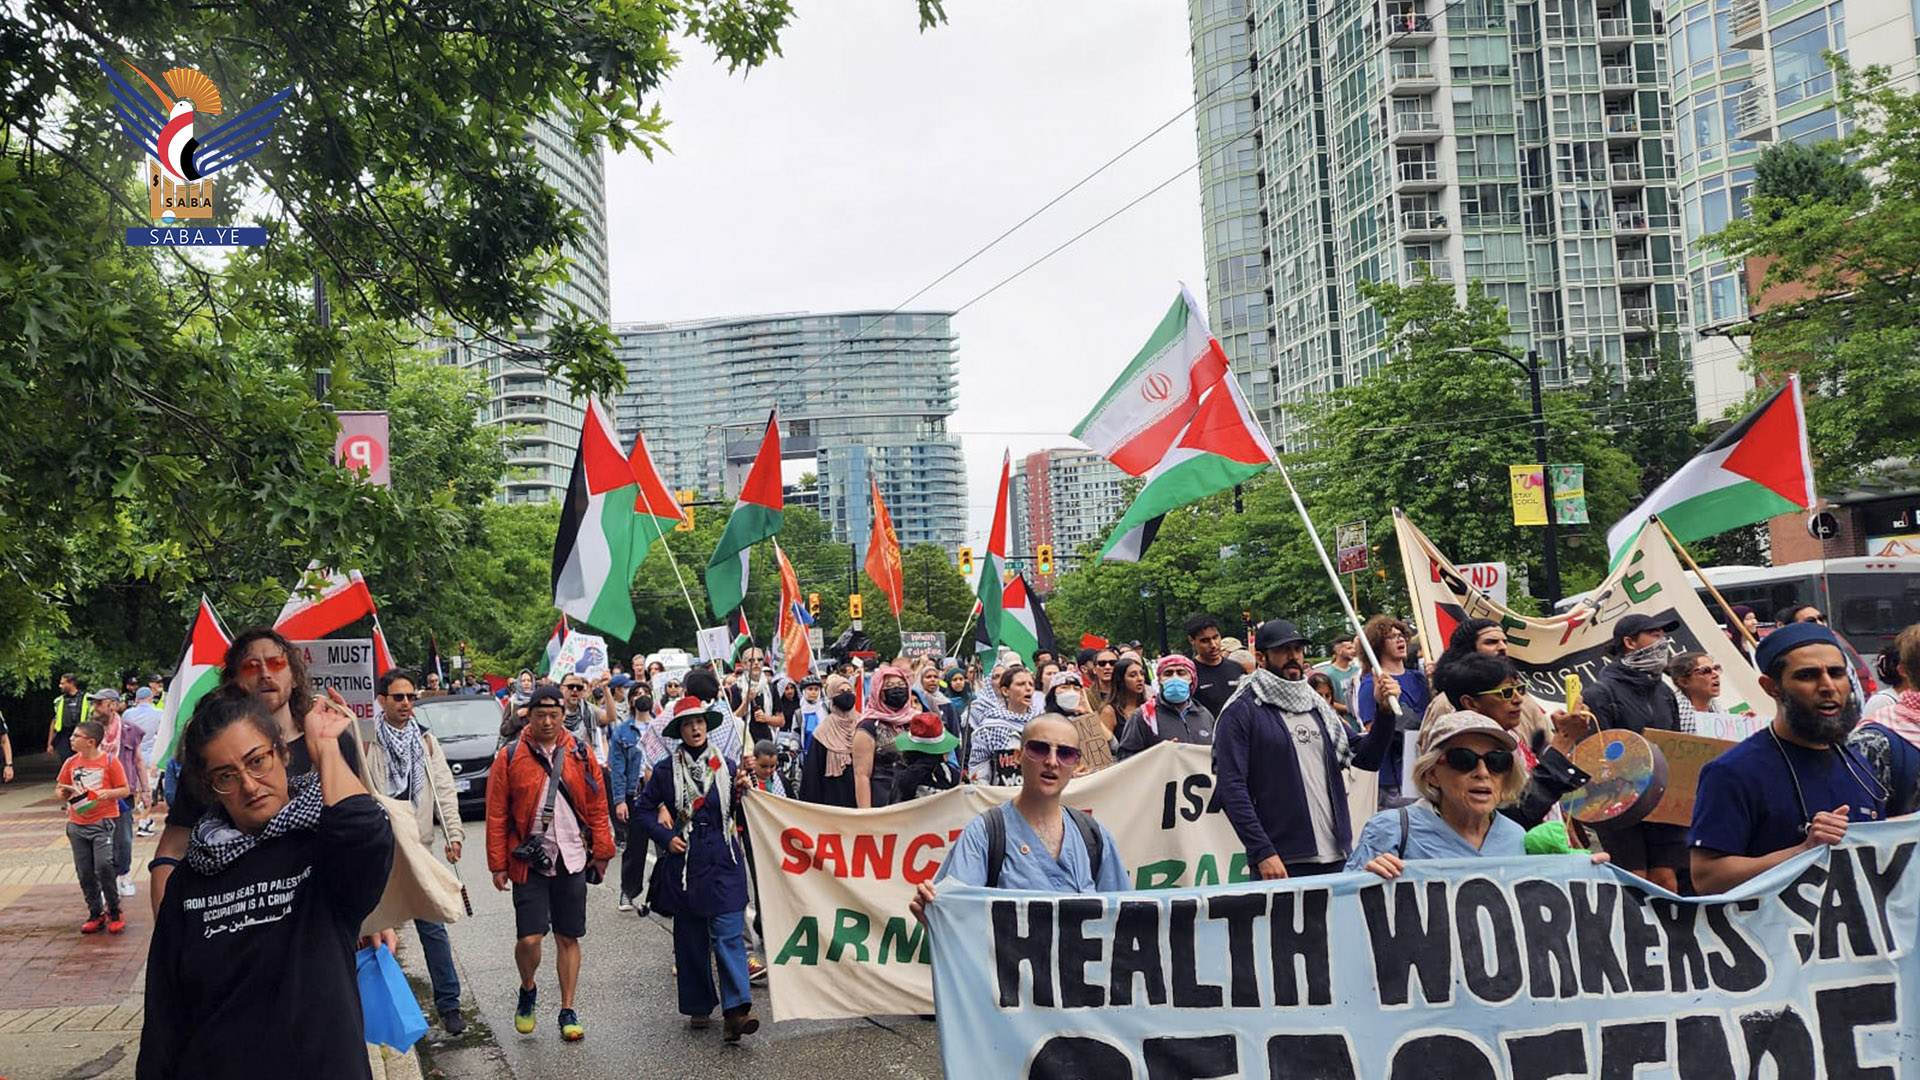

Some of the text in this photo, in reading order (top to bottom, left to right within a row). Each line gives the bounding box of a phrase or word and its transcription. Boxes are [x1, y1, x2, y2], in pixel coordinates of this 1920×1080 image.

[328, 645, 371, 664] MUST
[207, 891, 236, 907] SALISH
[236, 884, 255, 900] SEAS
[257, 881, 268, 894] TO
[203, 902, 246, 923] OCCUPATION
[248, 898, 256, 911] IS
[258, 896, 266, 909] A
[991, 841, 1919, 1008] HEALTH WORKERS SAY
